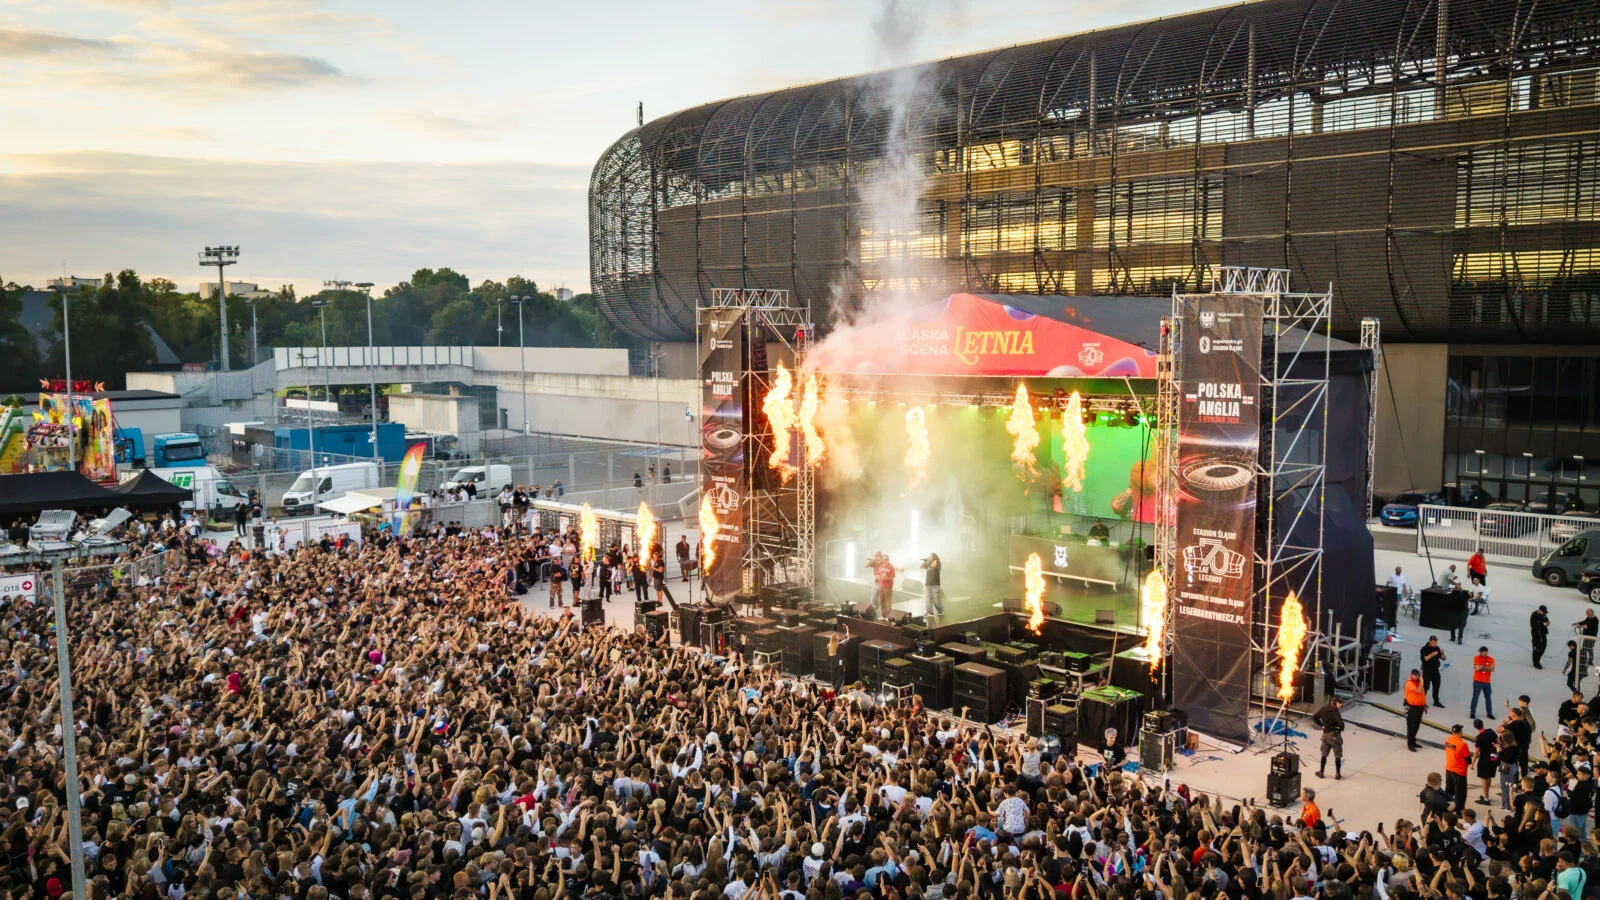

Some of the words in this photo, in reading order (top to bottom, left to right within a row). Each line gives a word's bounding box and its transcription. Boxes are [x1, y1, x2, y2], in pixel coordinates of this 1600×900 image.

[895, 328, 949, 343] LĄSKA
[901, 343, 949, 356] SCENA
[952, 326, 1034, 365] LETNIA
[711, 371, 733, 382] POLSKA
[1198, 382, 1242, 399] POLSKA
[1198, 400, 1240, 417] ANGLIA
[1193, 528, 1217, 537] STADION
[1199, 538, 1229, 575] 70
[1199, 574, 1222, 583] LEGENDY
